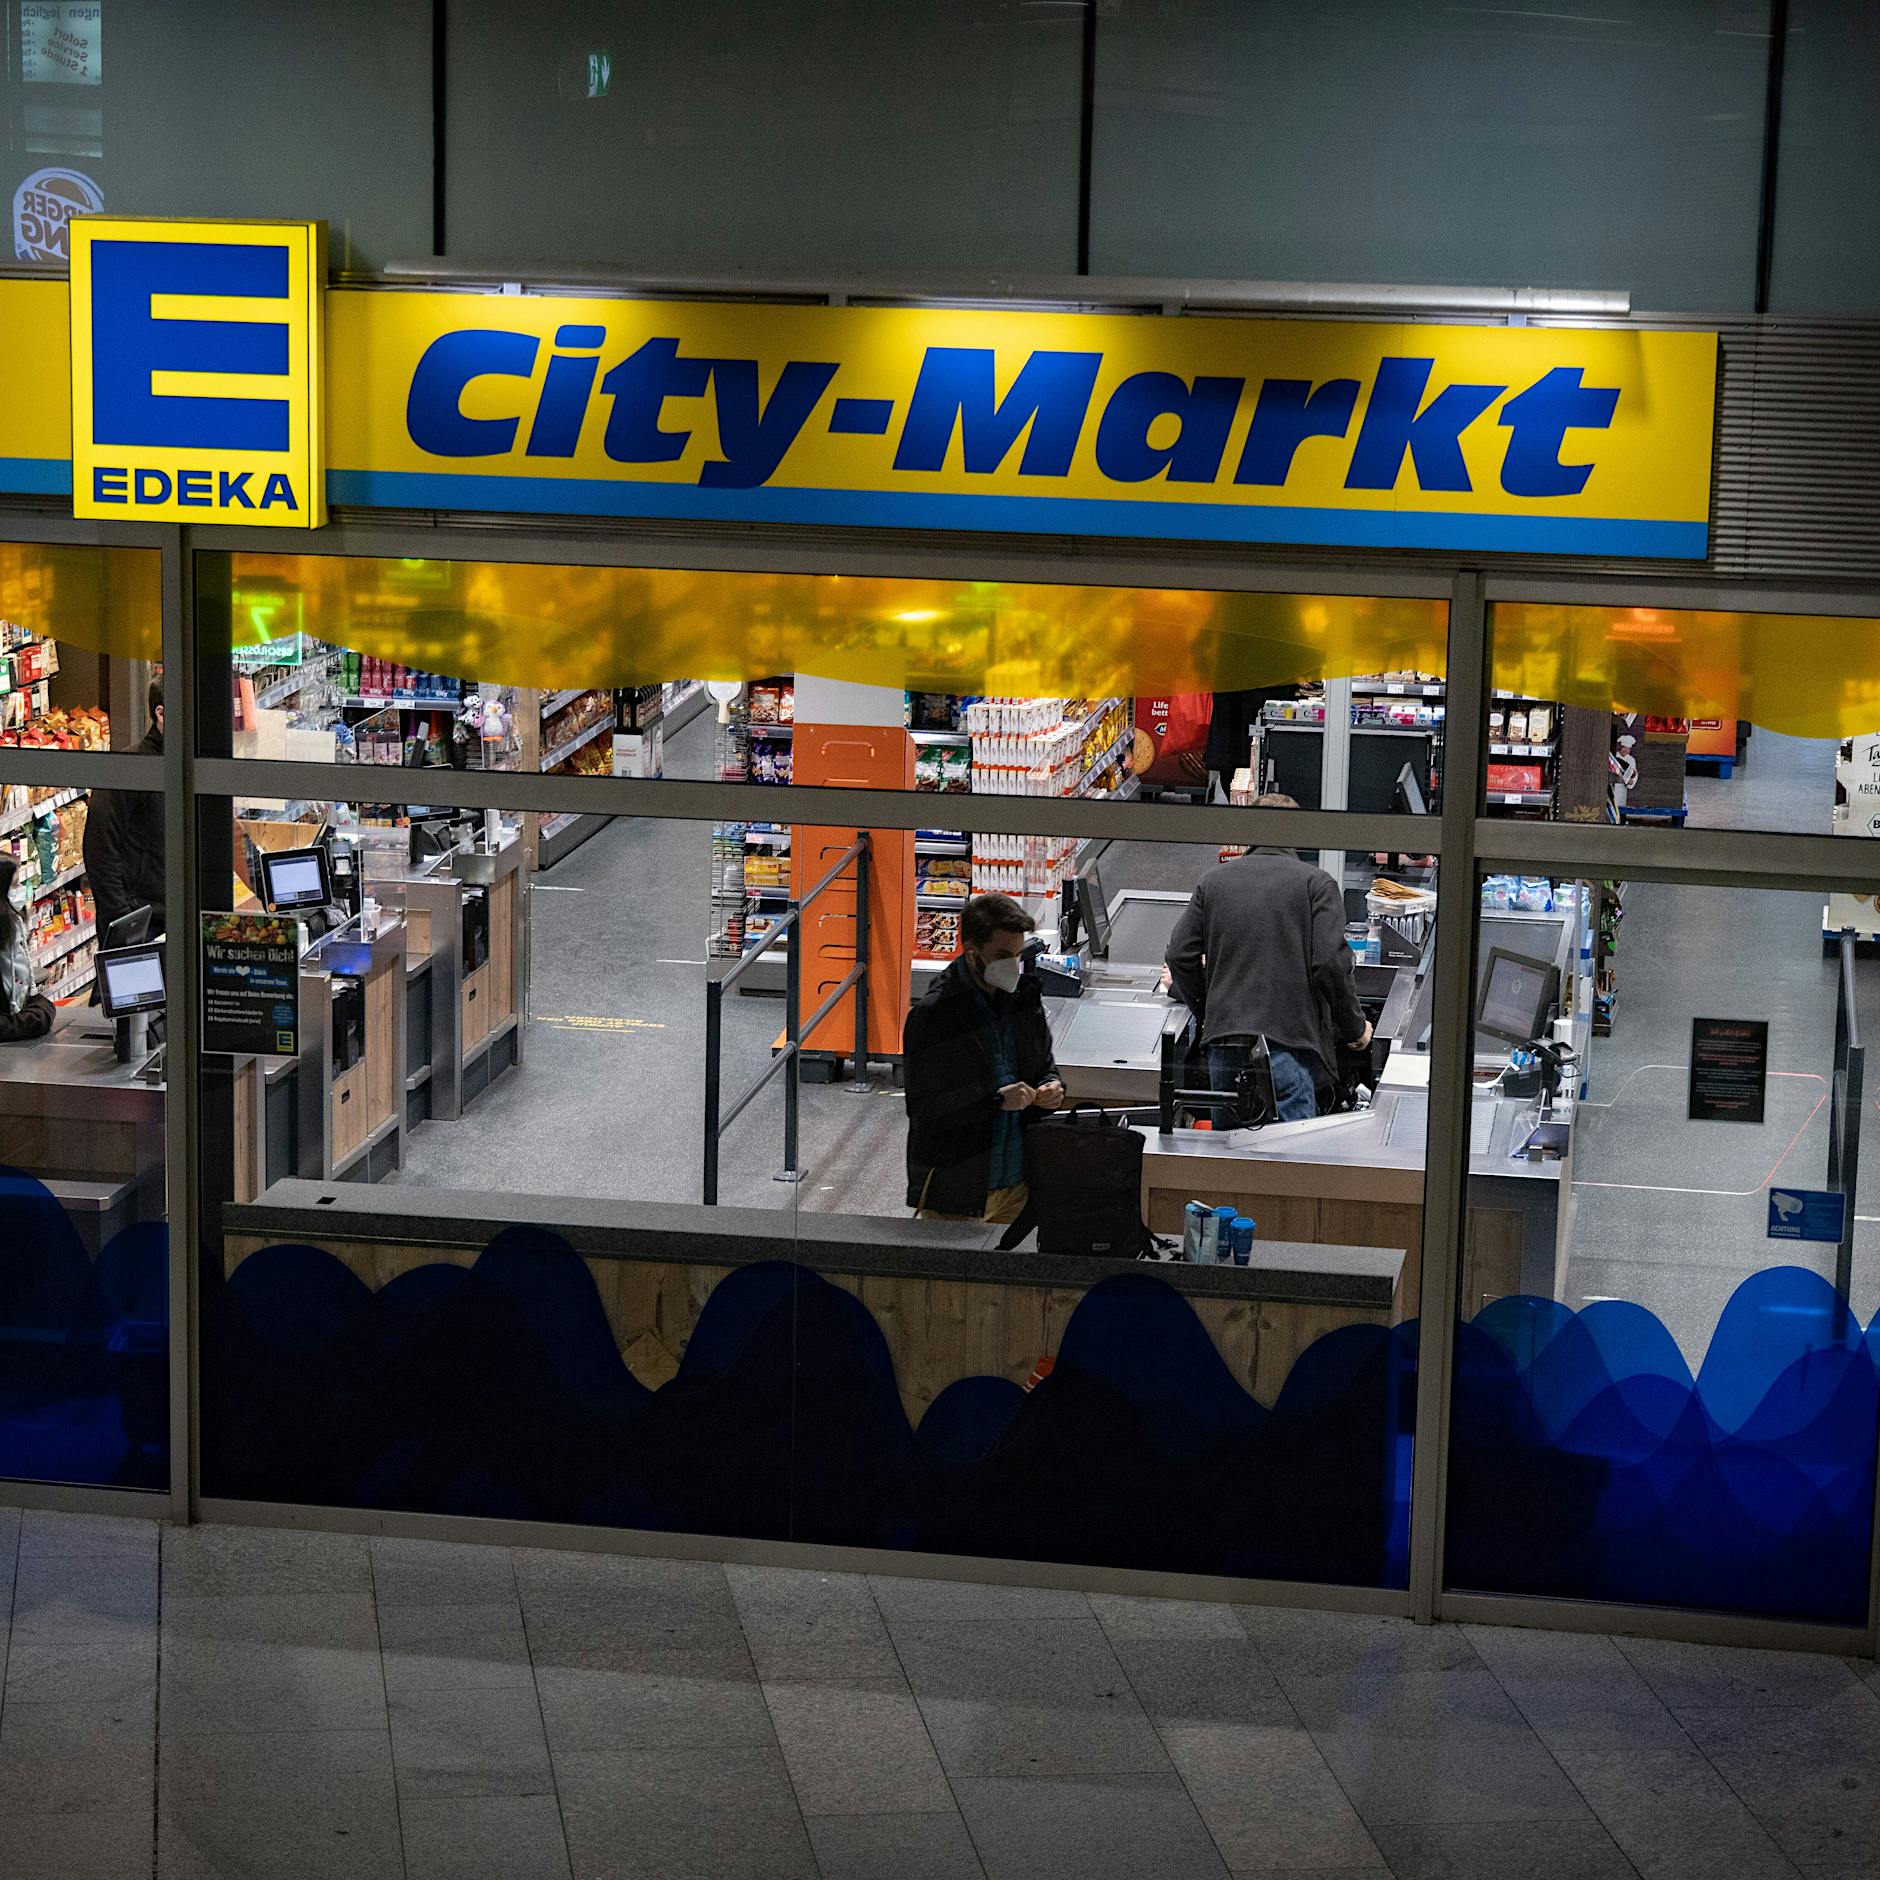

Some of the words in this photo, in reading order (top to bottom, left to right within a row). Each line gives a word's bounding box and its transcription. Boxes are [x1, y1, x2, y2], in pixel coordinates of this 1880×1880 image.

[91, 240, 290, 453] E
[405, 324, 1622, 498] City-Markt
[93, 466, 299, 510] EDEKA
[1153, 701, 1169, 709] Life
[207, 945, 225, 959] Wir
[227, 947, 266, 961] suchen
[267, 949, 294, 963] Dich!
[1770, 1224, 1800, 1234] ACHTUNG
